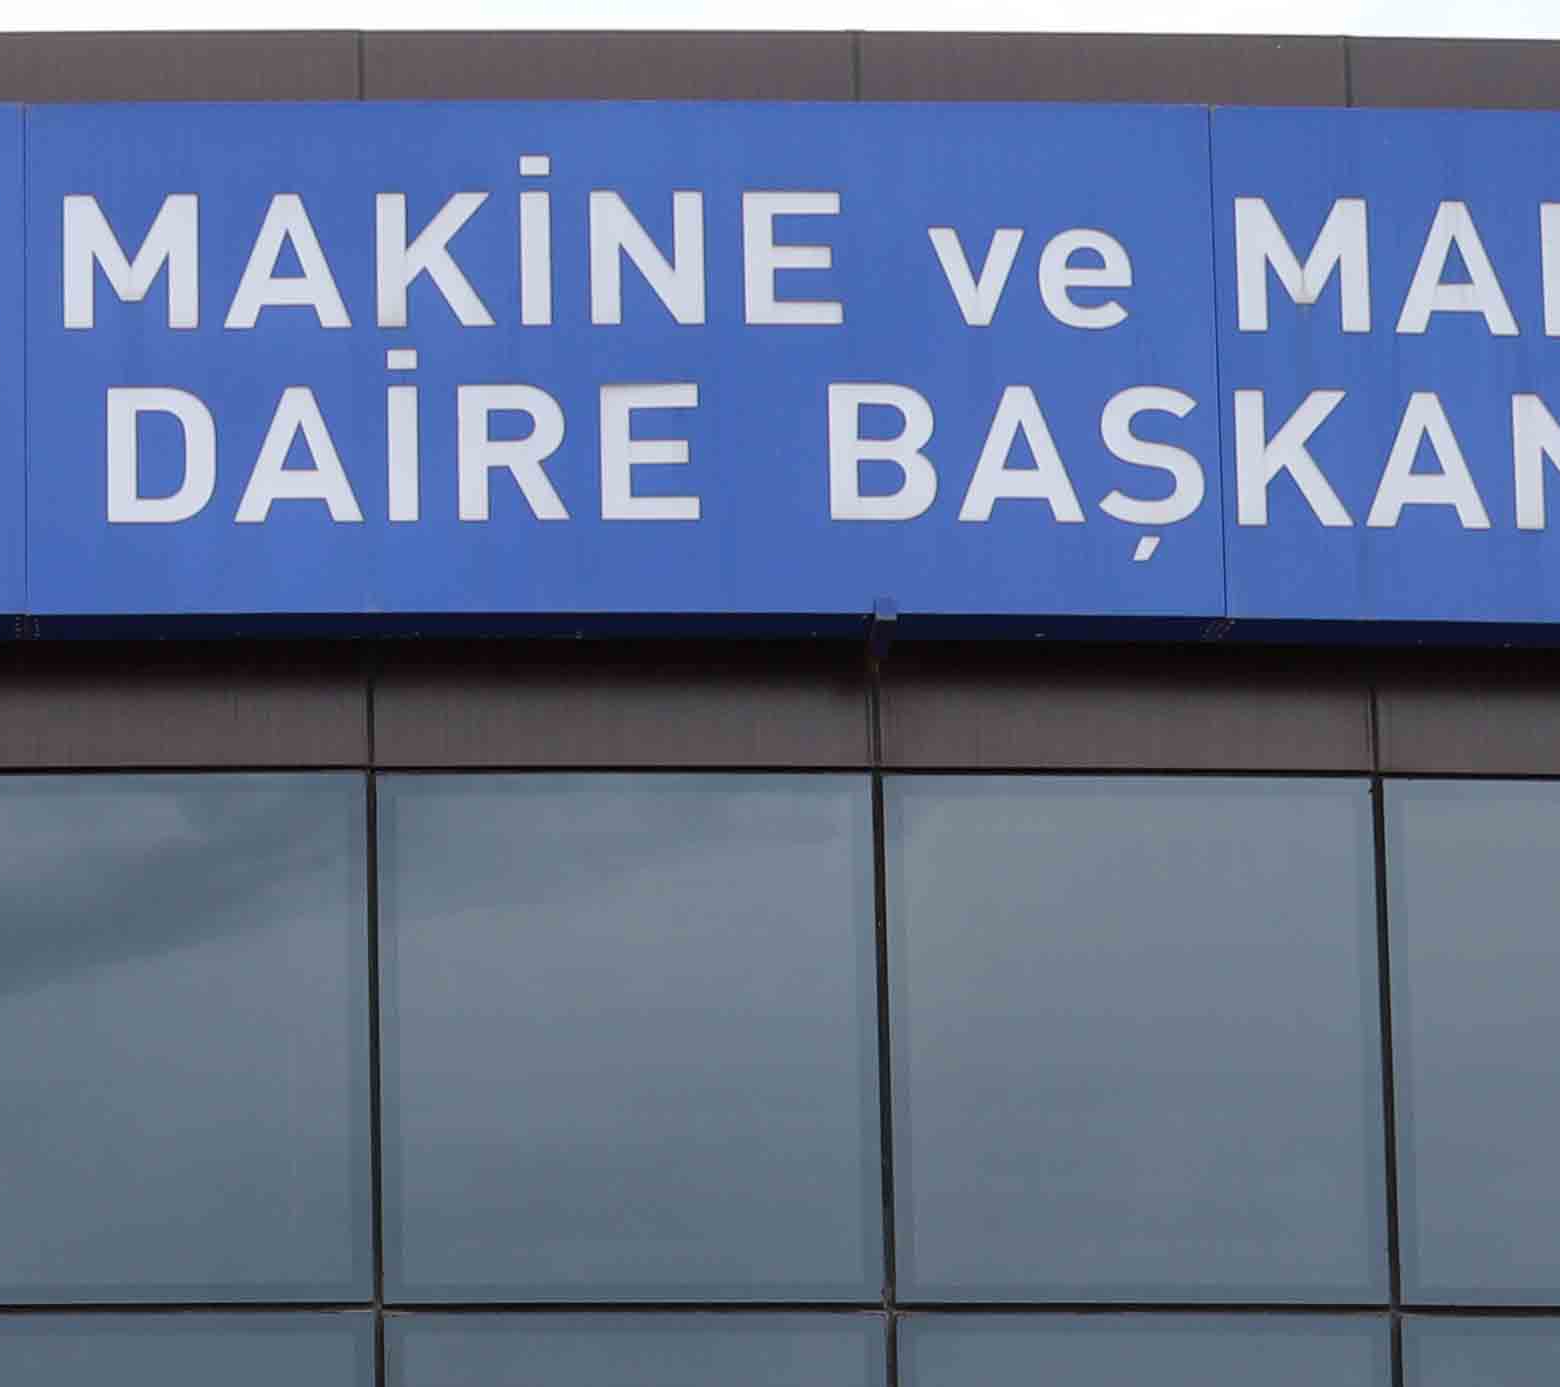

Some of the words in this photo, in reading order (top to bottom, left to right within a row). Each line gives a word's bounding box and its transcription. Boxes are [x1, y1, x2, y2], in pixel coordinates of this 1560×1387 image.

[61, 153, 846, 331] MAKİNE
[926, 225, 1134, 330] ve
[104, 347, 702, 526] DAİRE
